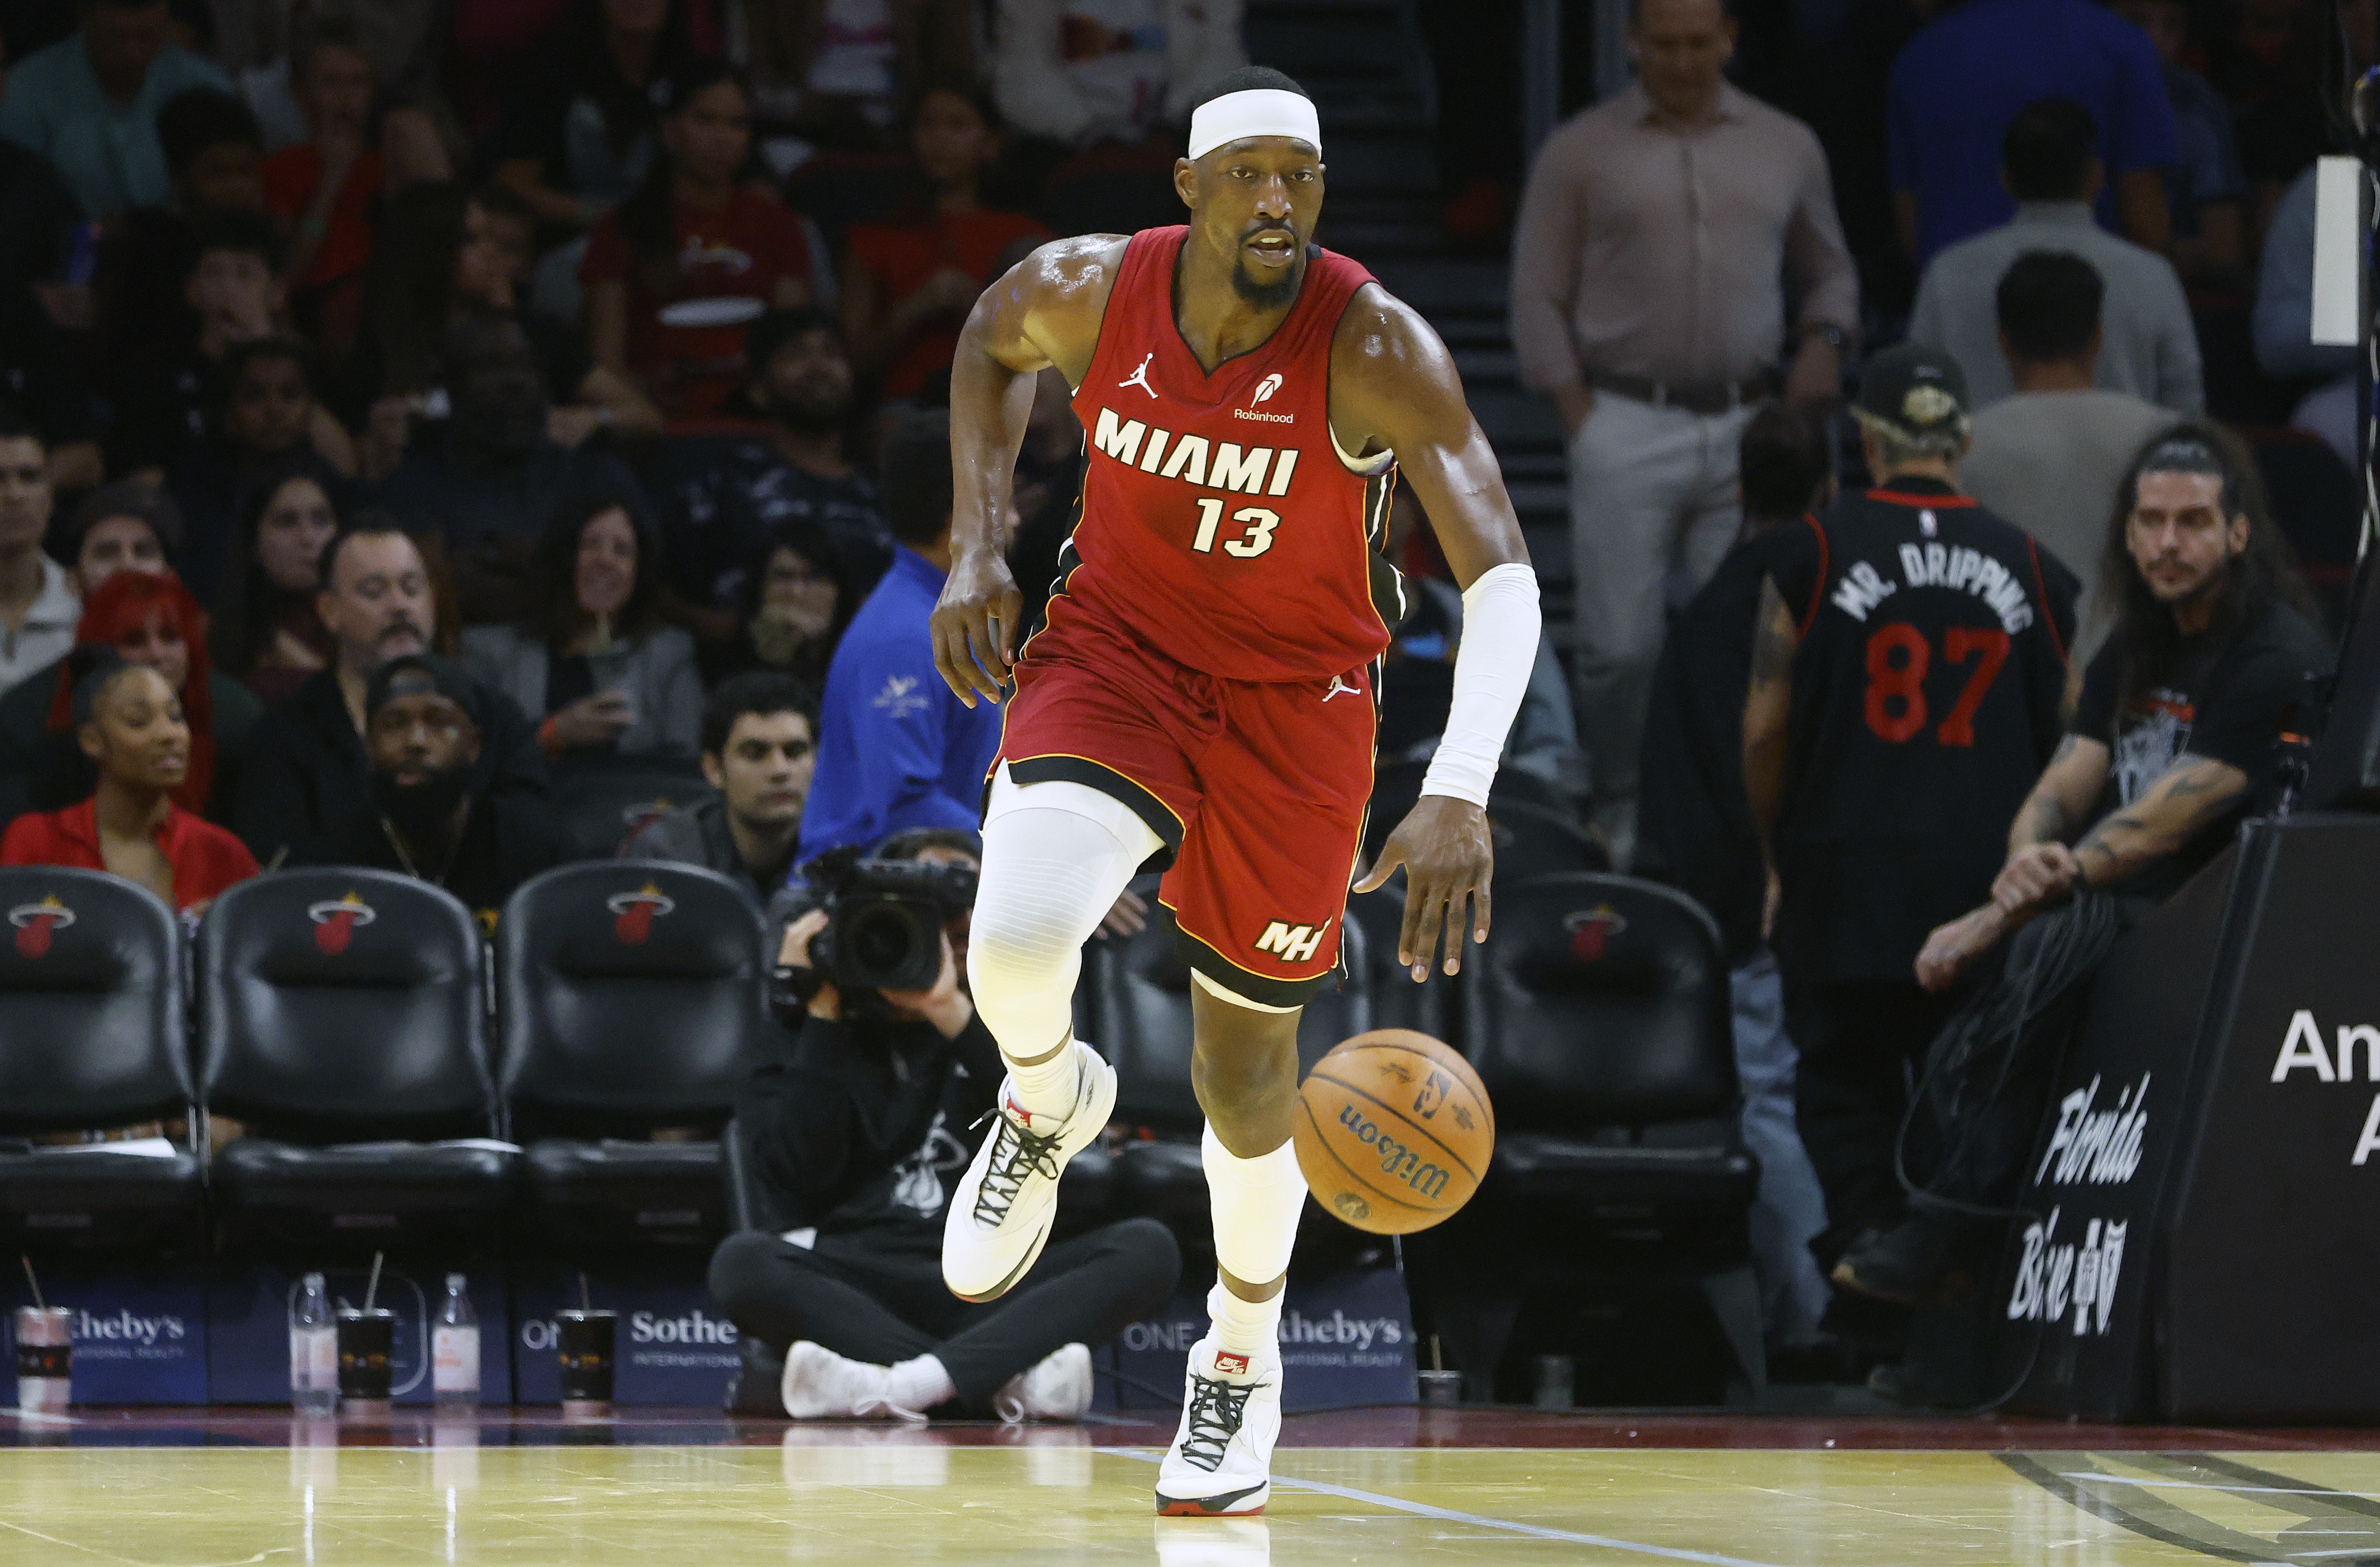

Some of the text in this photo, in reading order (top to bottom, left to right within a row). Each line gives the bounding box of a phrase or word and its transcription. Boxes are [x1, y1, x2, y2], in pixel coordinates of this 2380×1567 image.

[1234, 409, 1293, 424] Robinhood
[1093, 406, 1299, 497] MIAMI
[1192, 497, 1282, 558] 13
[1831, 559, 1897, 623] MR.
[1864, 622, 2010, 747] 87
[1338, 1103, 1451, 1200] Wilson
[2034, 1070, 2151, 1186] Florida
[632, 1309, 738, 1344] Sothe
[1123, 1322, 1194, 1352] ONE
[1221, 1356, 1240, 1368] NIKE
